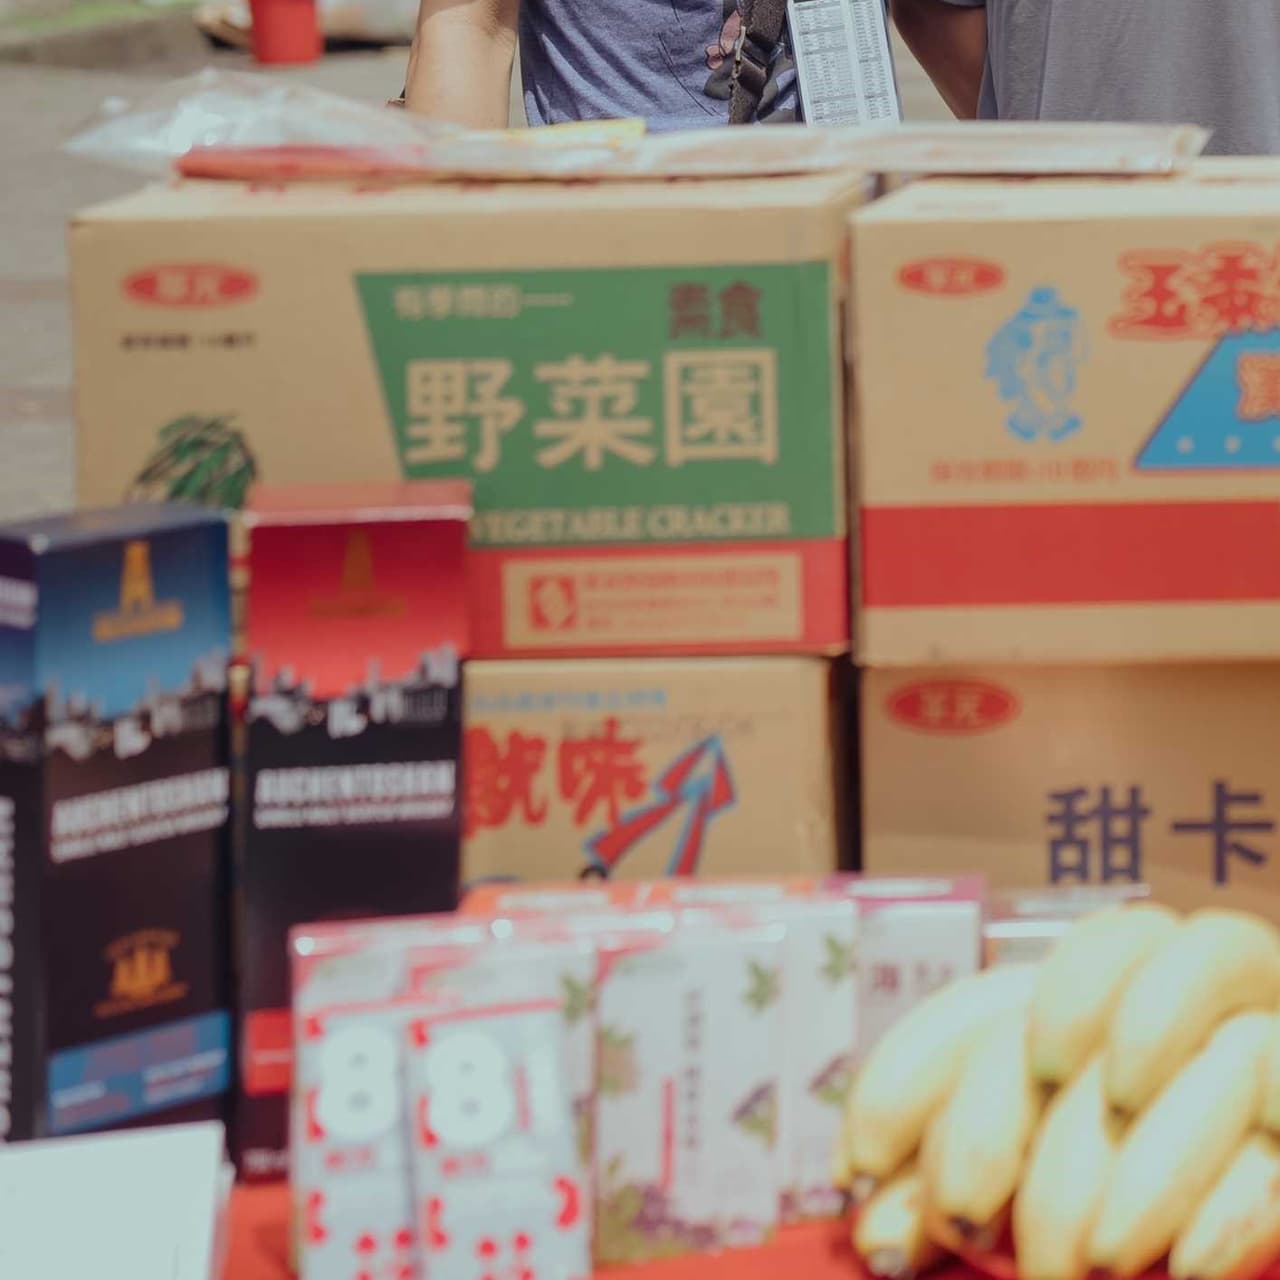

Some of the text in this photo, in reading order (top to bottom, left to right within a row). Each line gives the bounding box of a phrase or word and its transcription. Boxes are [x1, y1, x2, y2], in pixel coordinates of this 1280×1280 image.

[668, 279, 763, 340] 素食
[404, 347, 779, 473] 野菜園
